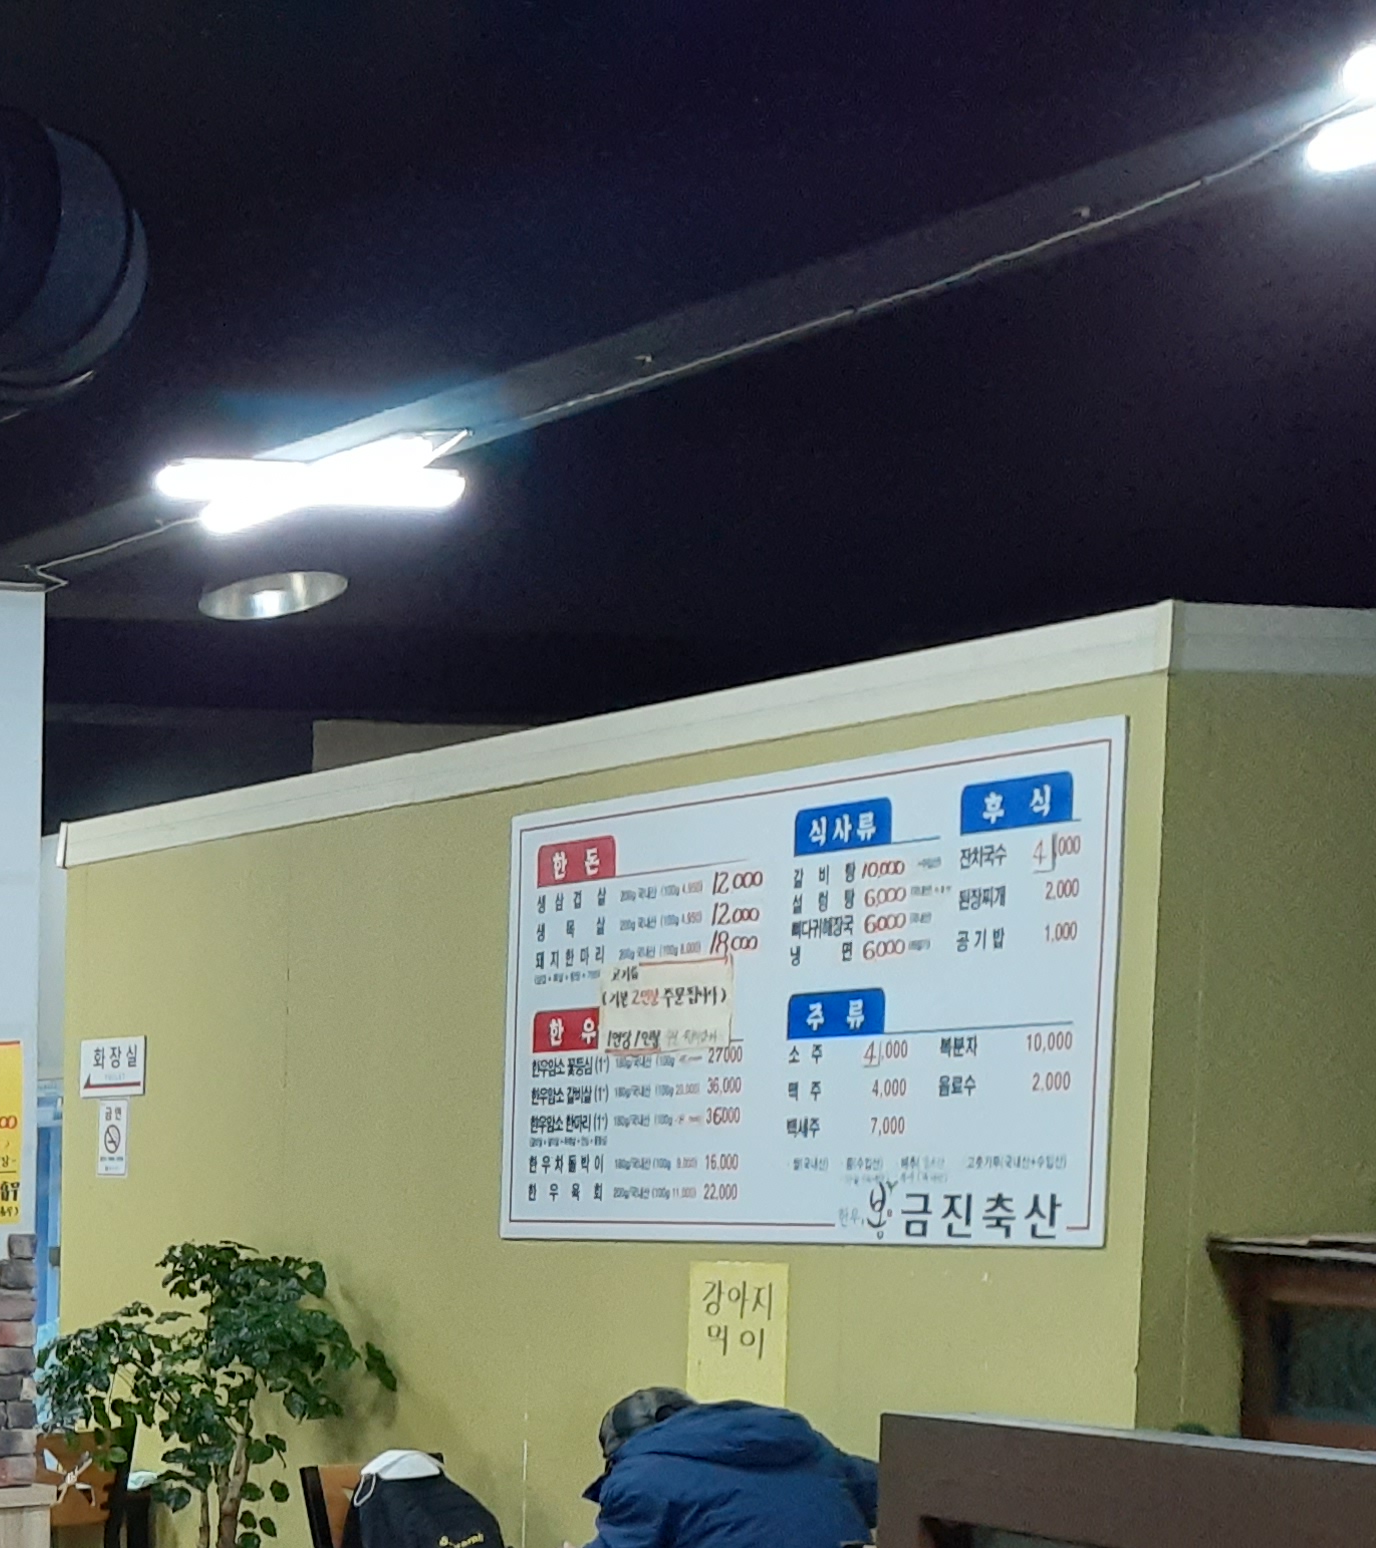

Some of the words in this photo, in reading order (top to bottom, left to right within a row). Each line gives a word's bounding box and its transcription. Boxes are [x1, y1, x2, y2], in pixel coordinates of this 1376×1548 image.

[809, 811, 877, 846] 식사류
[960, 843, 1007, 871] 잔치국수
[958, 885, 1006, 911] 된장찌개
[93, 1044, 138, 1069] 화장실
[940, 1034, 978, 1058] 복분자
[1025, 1031, 1073, 1054] 10,000
[707, 1076, 742, 1097] 36,000
[871, 1077, 907, 1098] 4,000
[938, 1074, 977, 1098] 음료수
[786, 1117, 821, 1139] 백세주
[870, 1115, 905, 1137] 7,000
[704, 1153, 739, 1172] 16,000
[703, 1182, 738, 1201] 22,000
[901, 1191, 1063, 1240] 금진축산
[702, 1280, 773, 1321] 강아지
